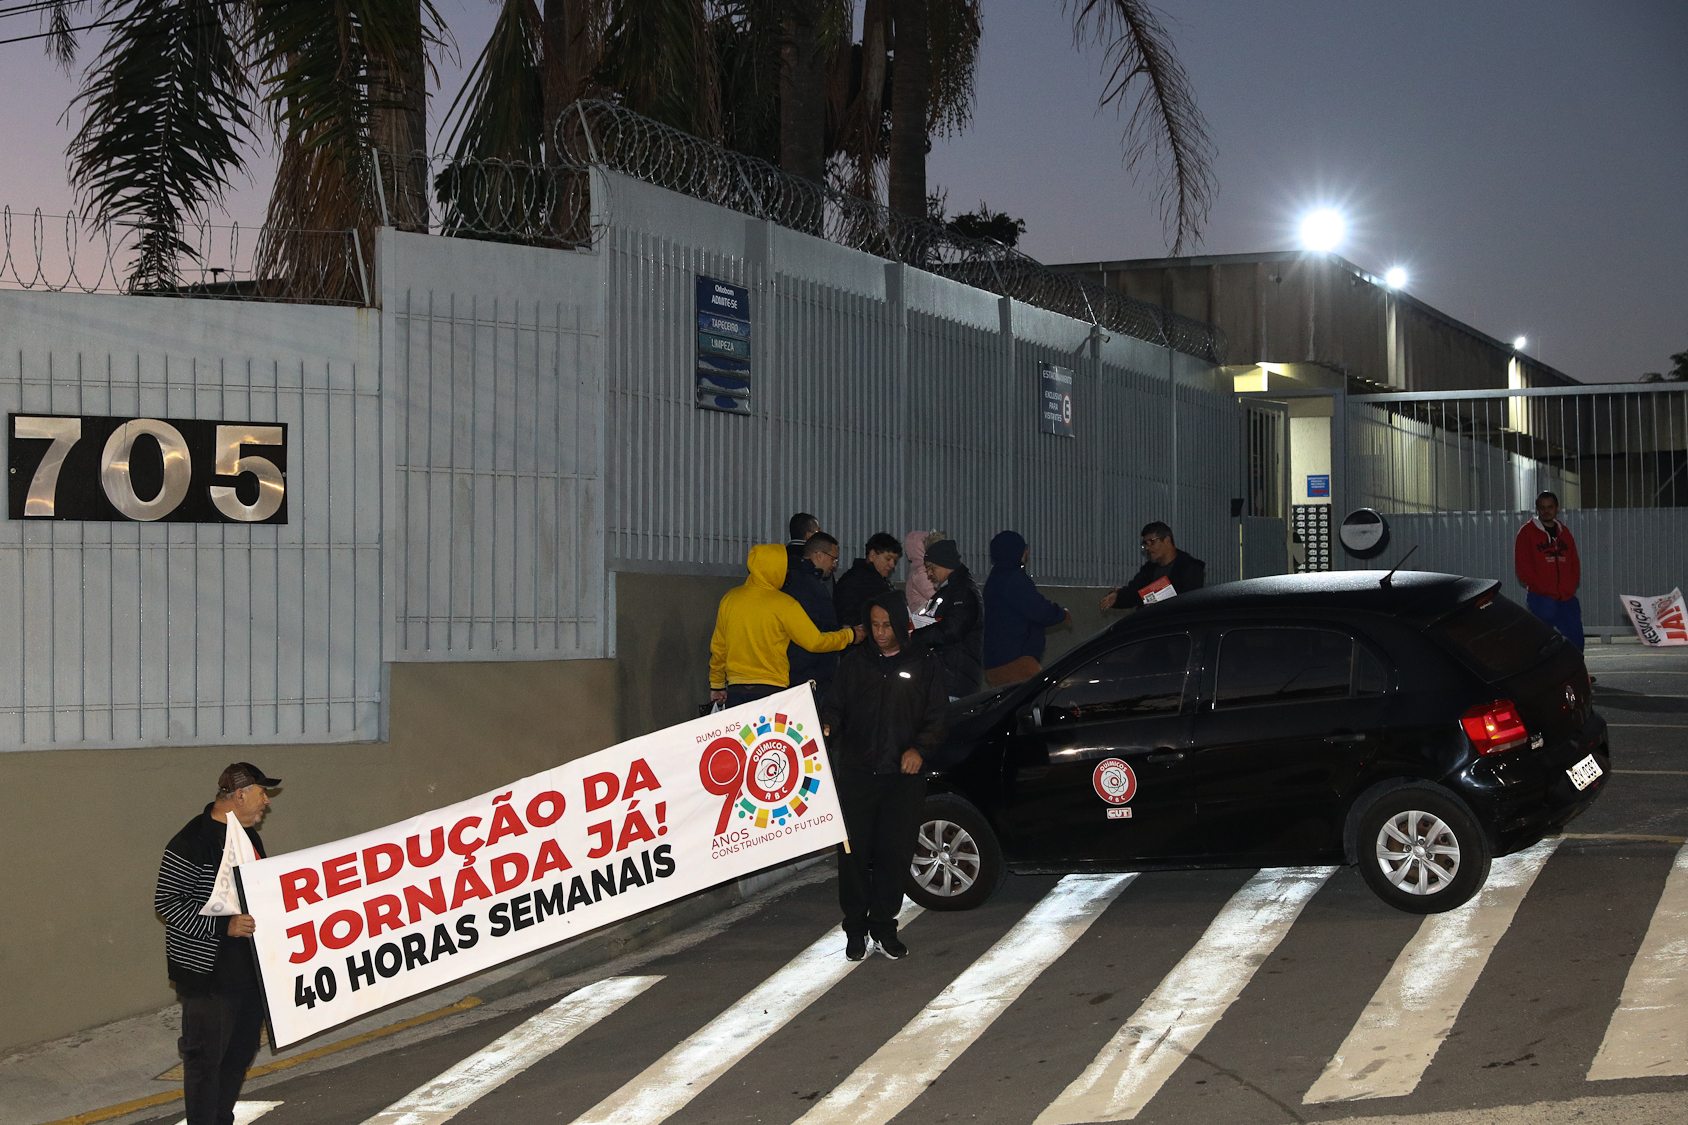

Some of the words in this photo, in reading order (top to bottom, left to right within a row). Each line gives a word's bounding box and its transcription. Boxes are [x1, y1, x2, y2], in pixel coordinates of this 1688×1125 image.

[711, 295, 738, 310] ADMITE-SE
[711, 318, 739, 333] TAPECEIRO
[711, 338, 735, 352] LIMPEZA
[1048, 401, 1059, 411] PARA
[15, 416, 285, 522] 705
[1655, 605, 1688, 642] JÁ!
[695, 729, 722, 744] RUMO
[725, 721, 742, 734] AOS
[752, 741, 788, 763] QUÍMICOS
[279, 791, 566, 913] REDUÇÃO
[583, 758, 662, 813] DA
[711, 830, 783, 860] CONSTRUINDO
[785, 826, 793, 835] O
[794, 813, 834, 833] FUTURO
[711, 828, 750, 850] ANOS
[285, 838, 573, 964] JORNADA
[586, 800, 669, 859] JÁ!
[294, 965, 338, 1010] 40
[345, 914, 479, 993] HORAS
[490, 844, 676, 937] SEMANAIS
